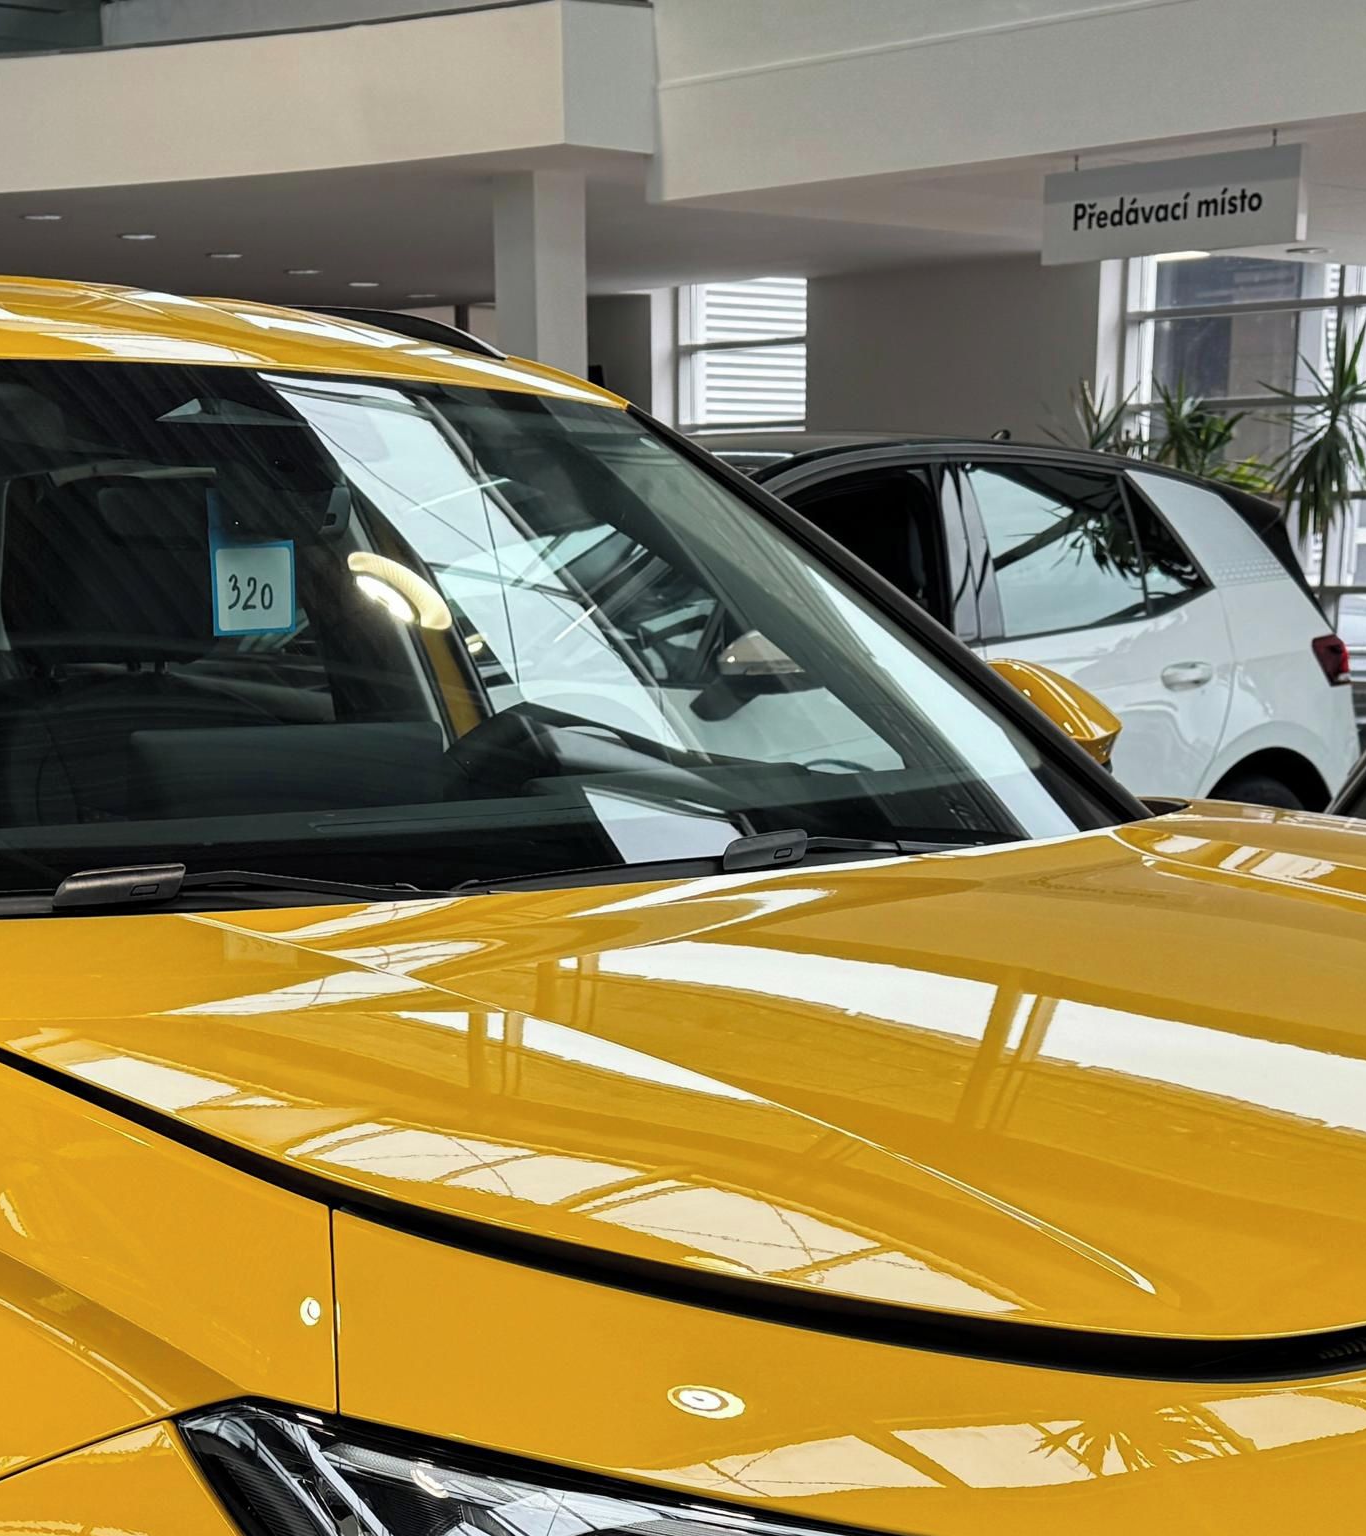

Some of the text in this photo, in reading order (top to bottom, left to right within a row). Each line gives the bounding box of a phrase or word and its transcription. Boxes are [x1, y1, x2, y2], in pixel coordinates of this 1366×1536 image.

[1073, 187, 1263, 231] Předávací místo
[227, 573, 274, 611] 320
